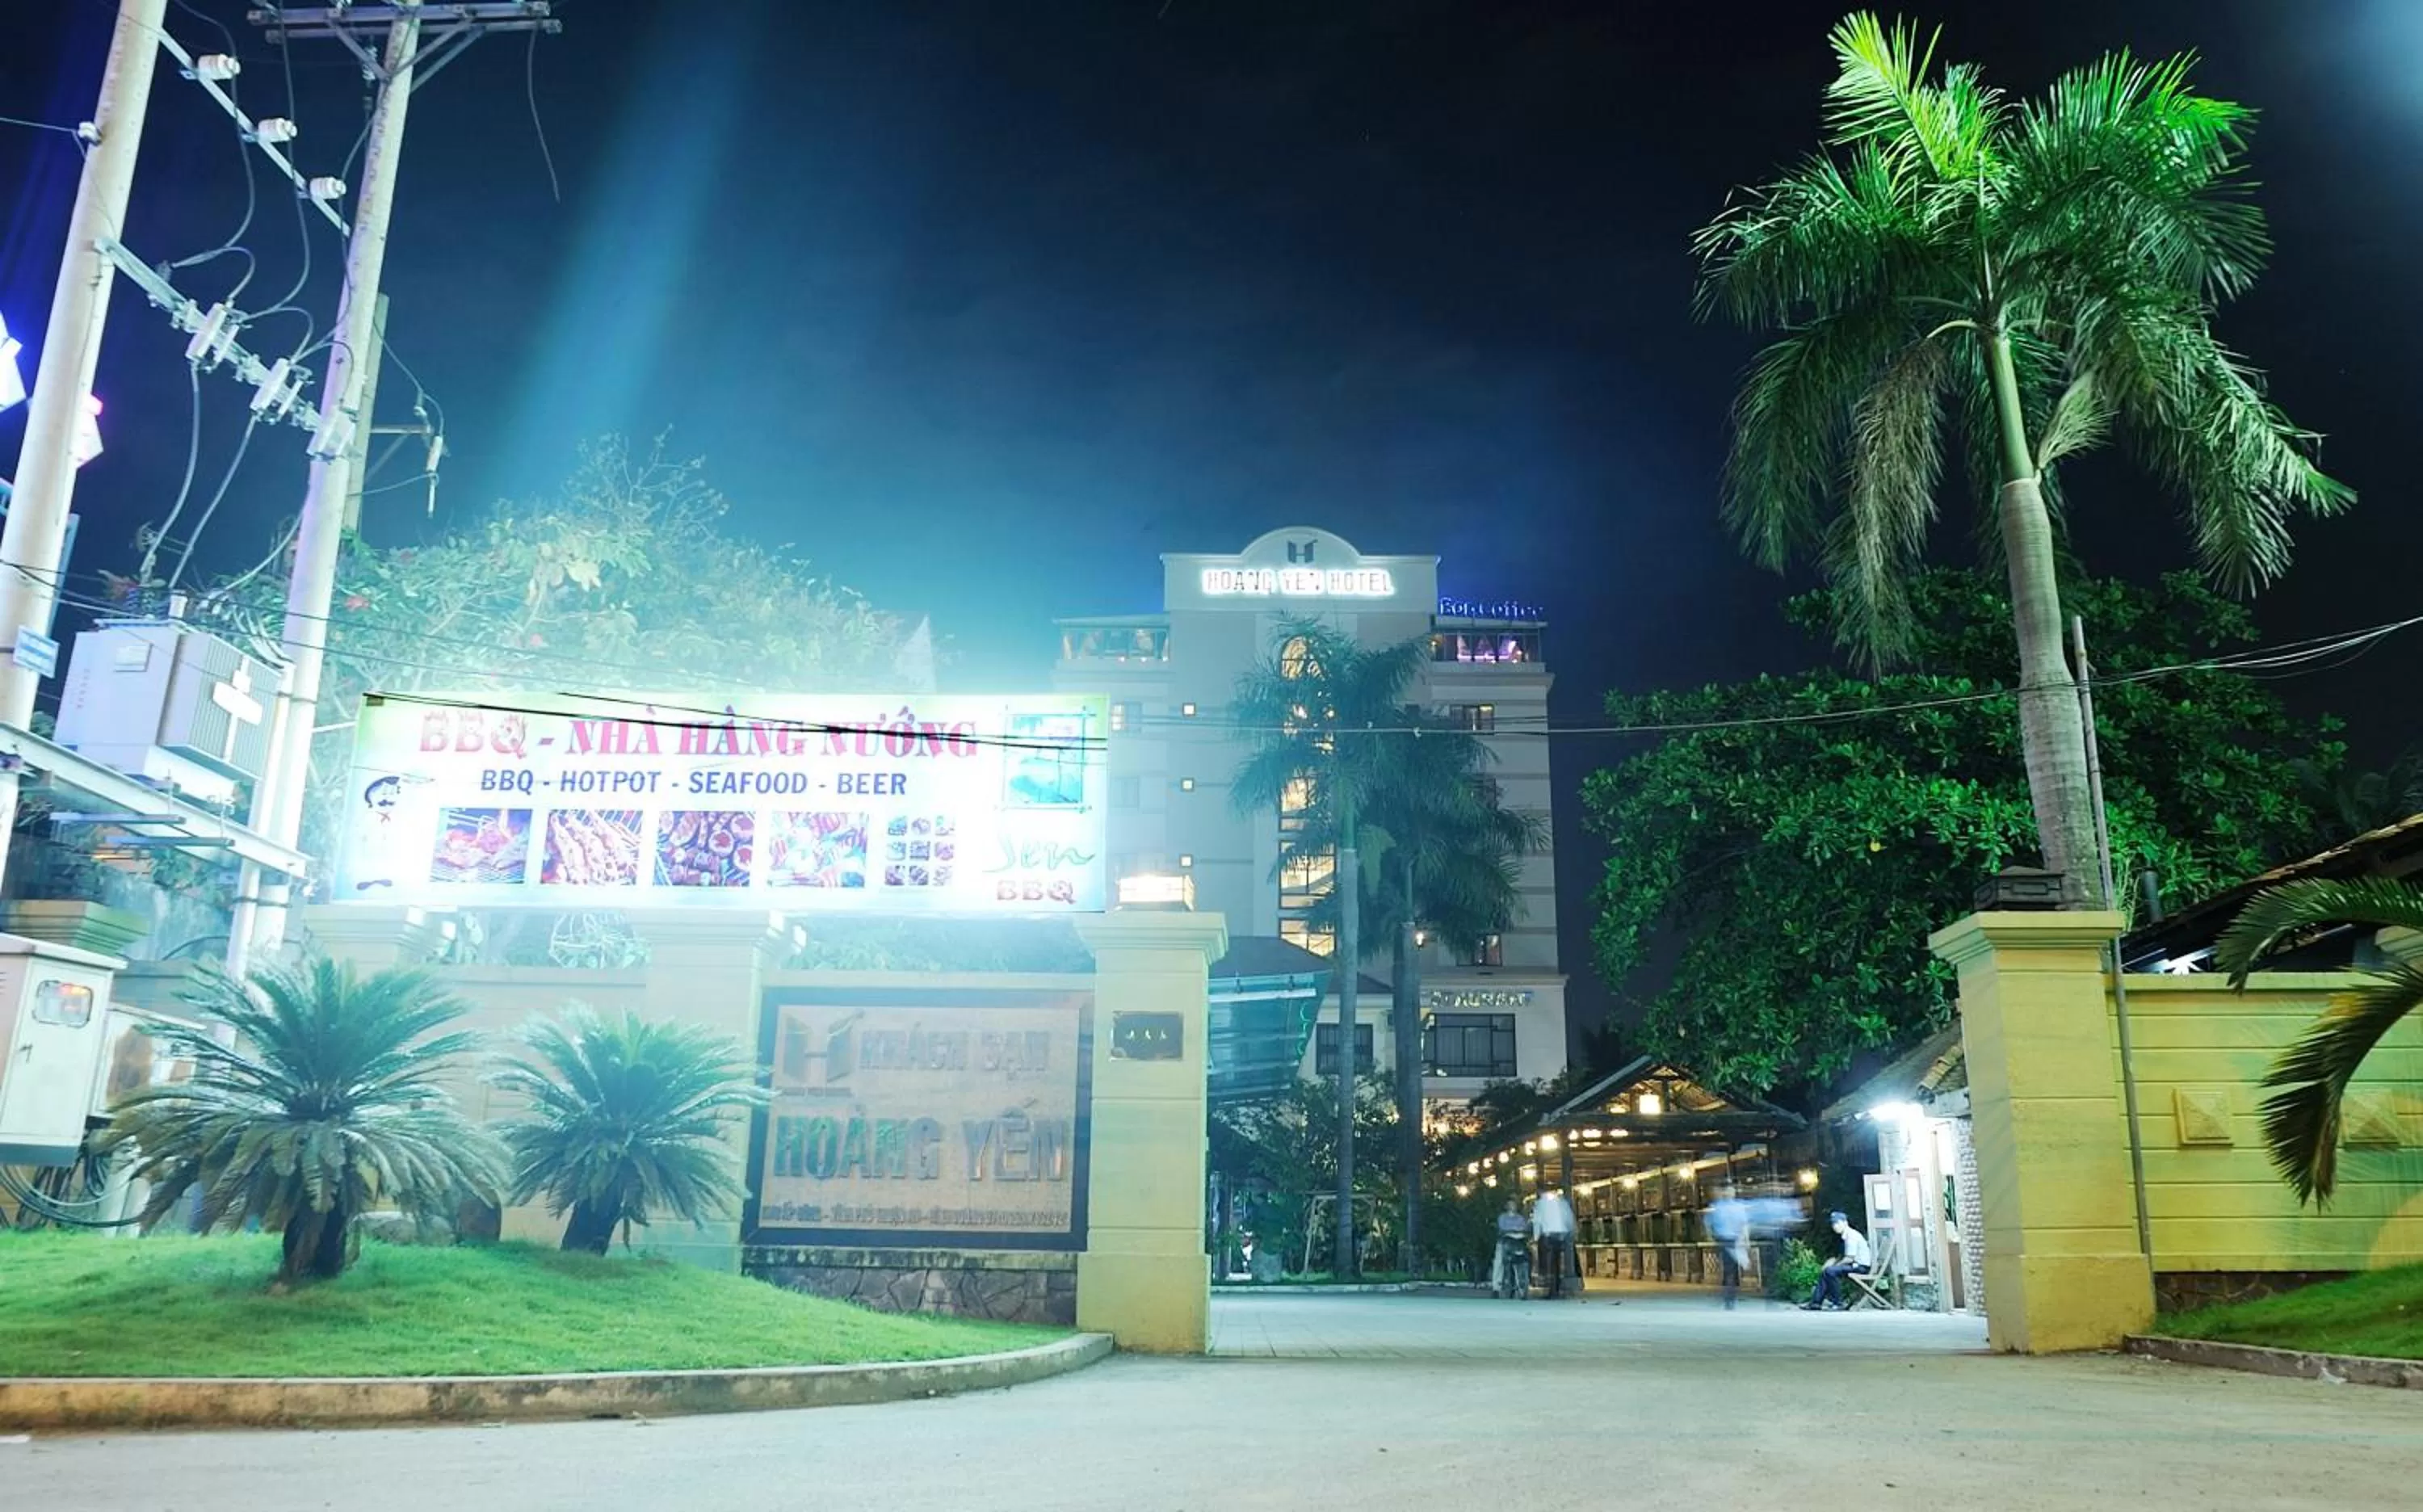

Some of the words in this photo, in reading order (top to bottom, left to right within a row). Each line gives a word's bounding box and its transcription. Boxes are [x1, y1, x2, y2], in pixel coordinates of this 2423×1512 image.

[1206, 570, 1276, 594] HOANG
[1329, 570, 1393, 594] HOTEL
[419, 710, 528, 760] BBQ
[565, 704, 662, 756] NHÀ
[821, 705, 979, 759] NƯỚNG
[481, 769, 534, 796] BBQ
[560, 770, 661, 793] HOTPOT
[688, 771, 808, 795] SEAFOOD
[837, 772, 908, 796] BEER
[996, 880, 1077, 904] BBQ
[772, 1103, 943, 1180] HOÀNG
[962, 1098, 1069, 1182] YẾN
